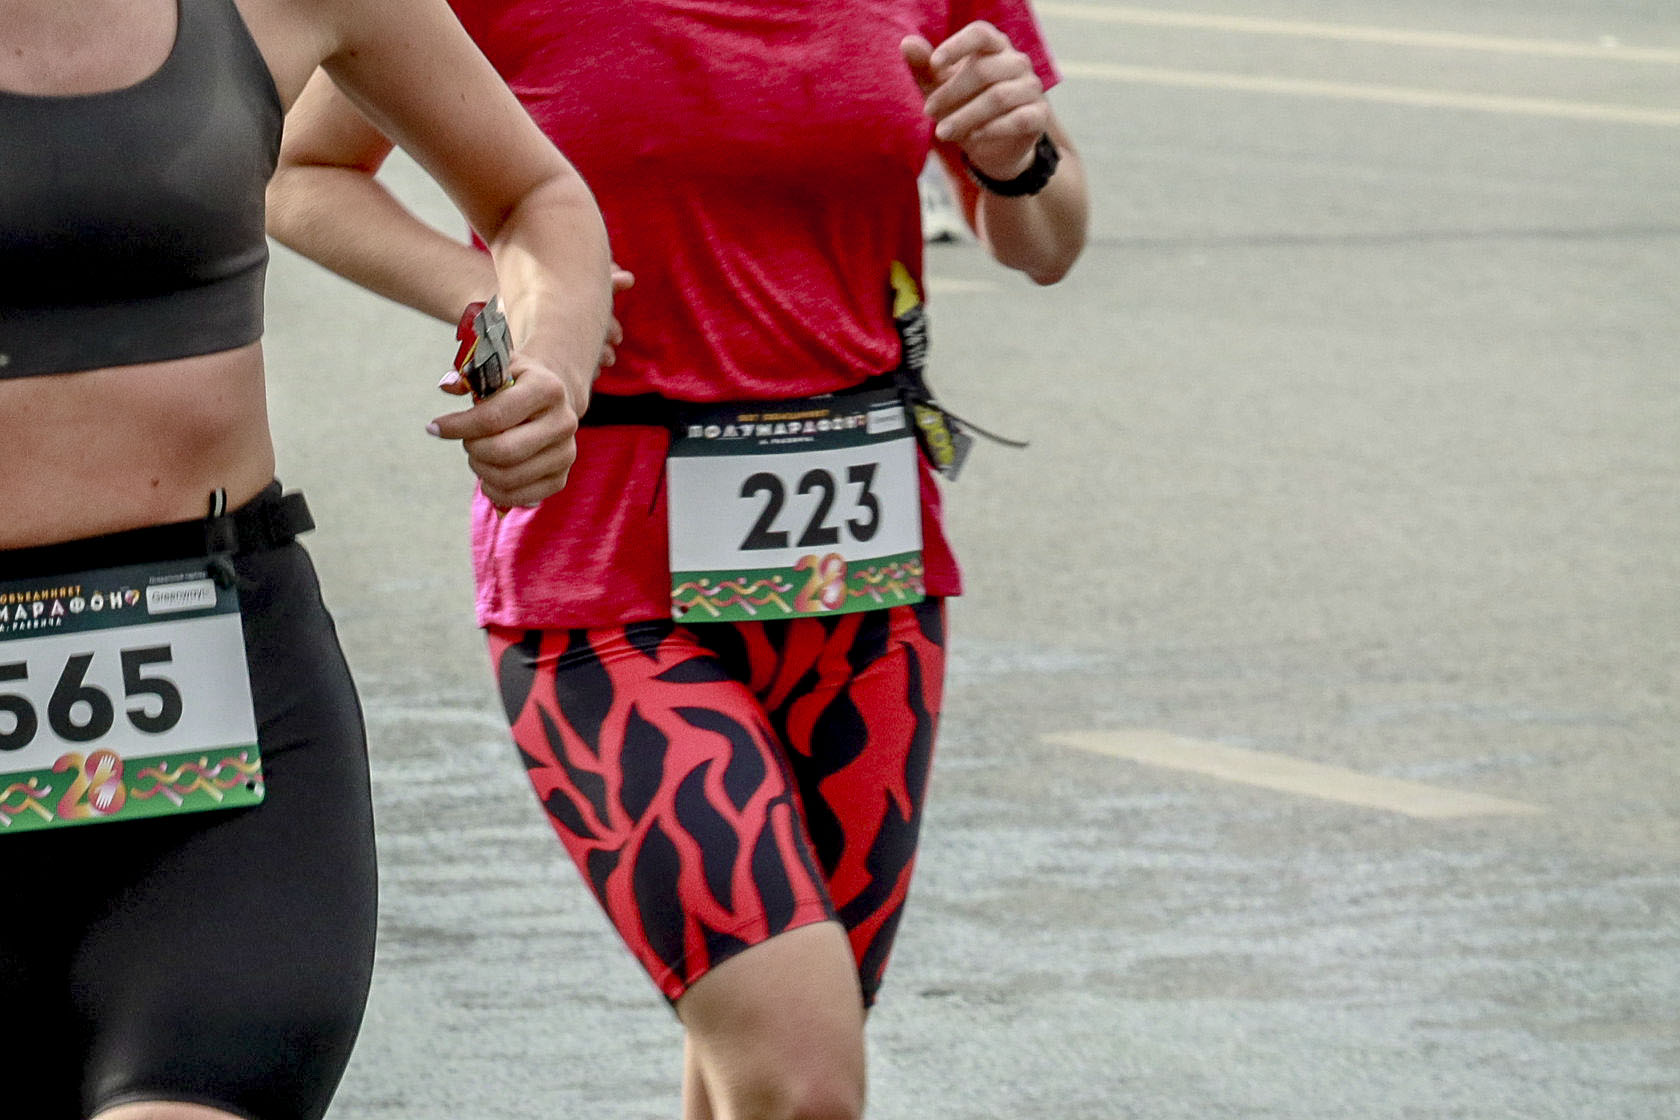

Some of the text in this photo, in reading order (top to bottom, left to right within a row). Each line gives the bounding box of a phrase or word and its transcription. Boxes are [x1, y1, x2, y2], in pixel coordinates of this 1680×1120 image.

[738, 462, 881, 551] 223
[792, 552, 848, 613] 28
[51, 748, 127, 821] 28
